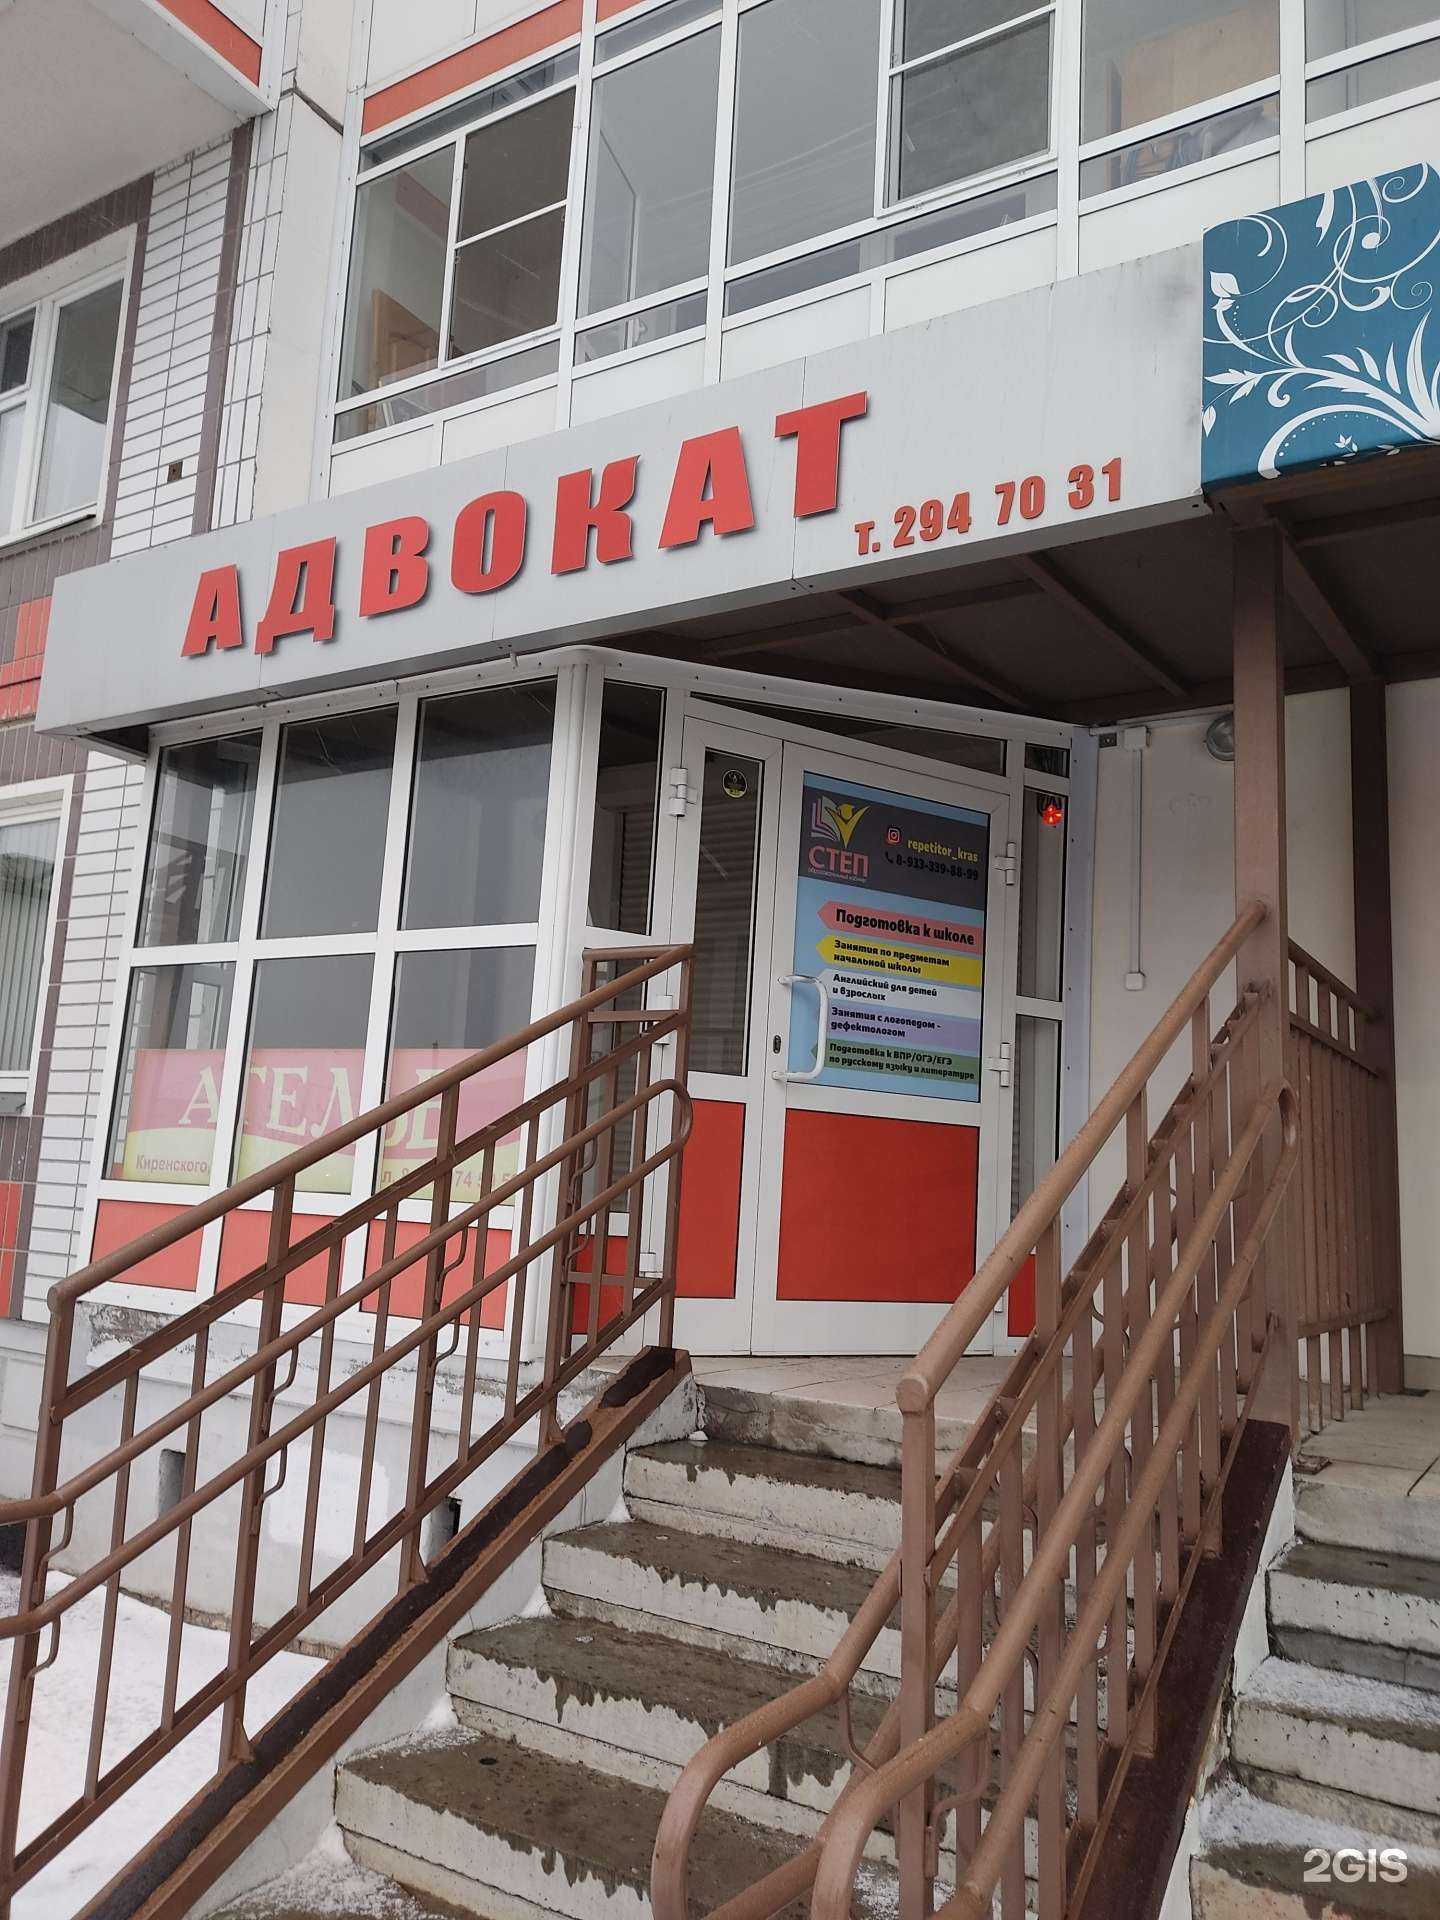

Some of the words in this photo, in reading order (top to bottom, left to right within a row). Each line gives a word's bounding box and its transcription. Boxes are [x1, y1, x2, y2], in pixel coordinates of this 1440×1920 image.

[893, 491, 972, 548] 294
[995, 475, 1046, 525] 70
[1067, 457, 1121, 510] 31
[180, 391, 868, 657] АДВОКАТ
[809, 845, 869, 877] СТЕП
[907, 839, 978, 862] repetitor_kras
[836, 908, 920, 935] Подготовка
[923, 923, 930, 938] к
[934, 926, 974, 945] школе
[834, 939, 878, 955] Занятия
[880, 948, 891, 957] по
[893, 950, 949, 967] предметам
[834, 954, 886, 969] начальной
[888, 961, 921, 974] школы
[833, 973, 889, 989] Английский
[890, 983, 907, 992] для
[908, 986, 937, 996] детей
[840, 987, 886, 1001] взрослых
[831, 1007, 875, 1020] Занятия
[884, 1016, 935, 1029] логопедом
[831, 1021, 905, 1037] дефектологом
[829, 1043, 885, 1057] Подготовка
[886, 1049, 892, 1058] к
[893, 1050, 952, 1066] ВПР/ОГЭ/ЕГЭ
[829, 1056, 840, 1064] по
[842, 1056, 883, 1070] русскому
[885, 1063, 912, 1074] языку
[921, 1066, 974, 1080] литературе
[178, 1065, 447, 1150] АЕЛЕ
[136, 1155, 208, 1174] Киренского
